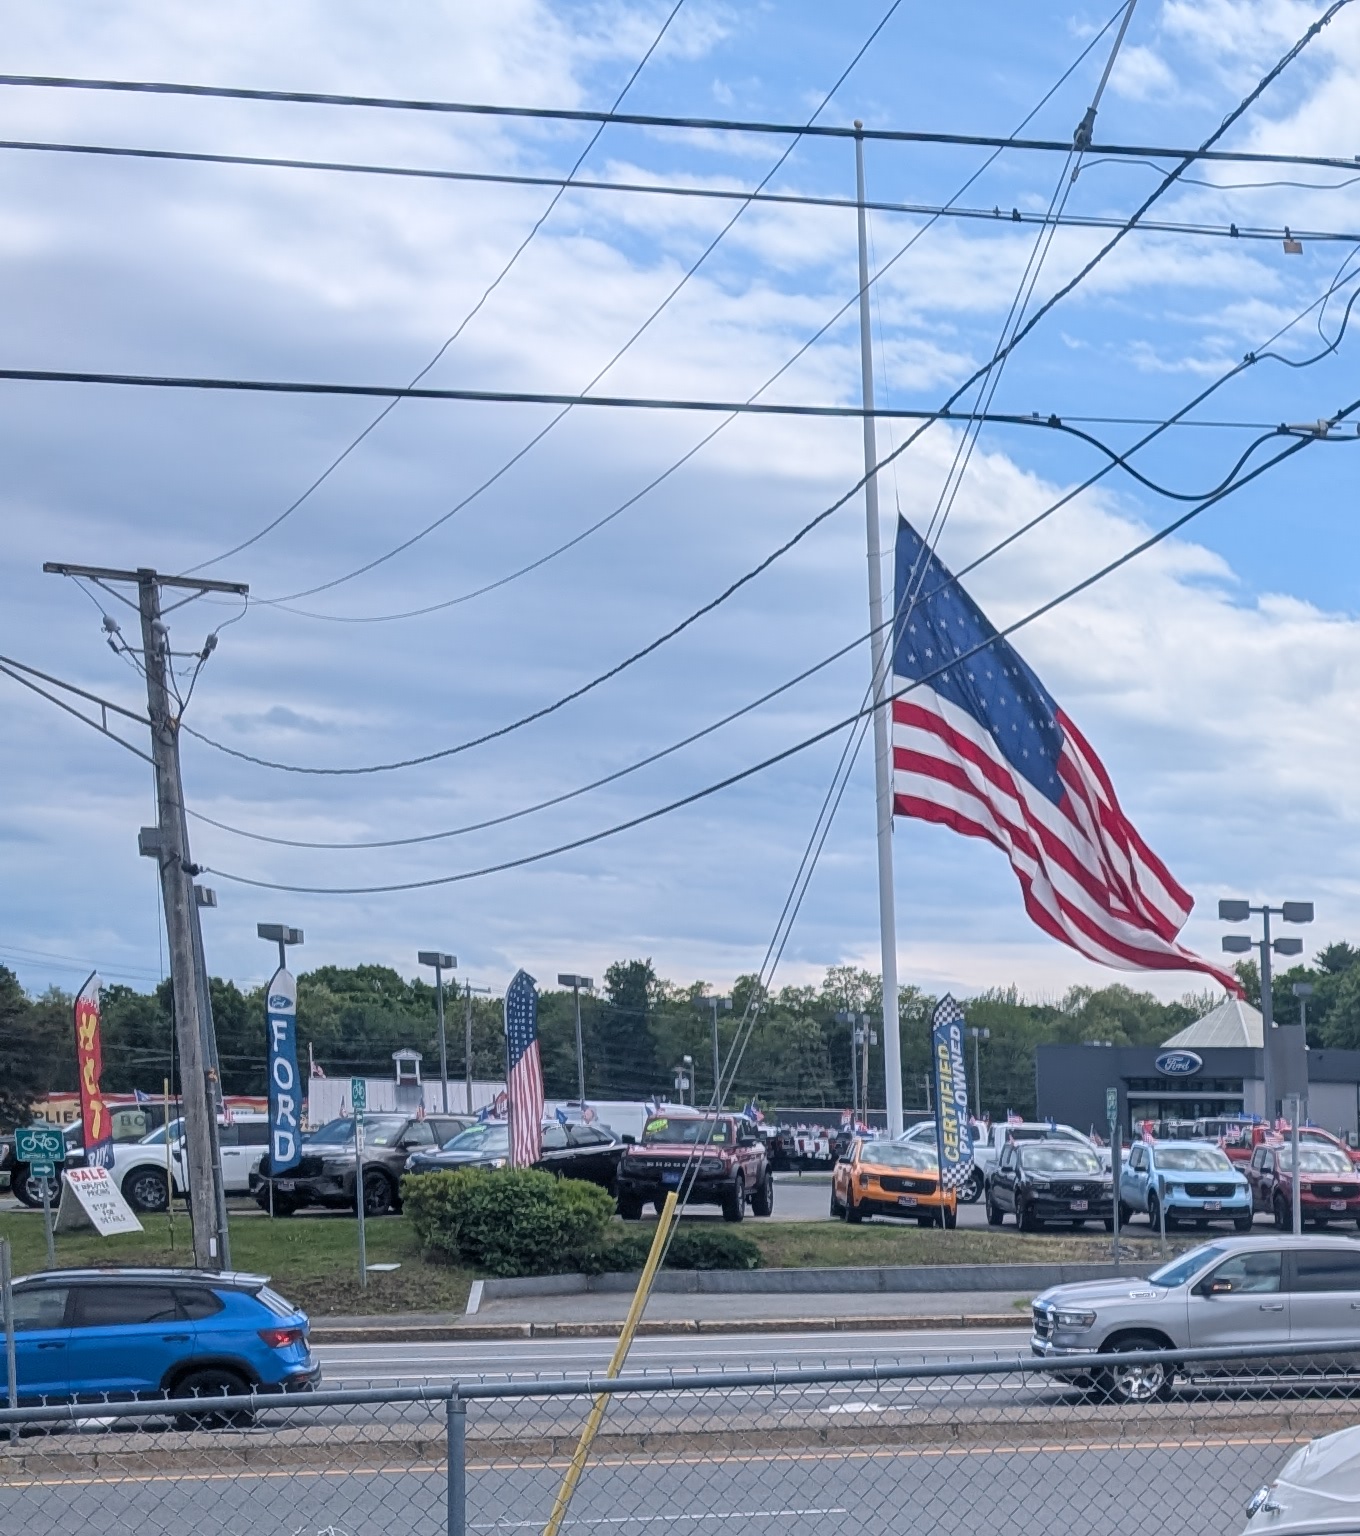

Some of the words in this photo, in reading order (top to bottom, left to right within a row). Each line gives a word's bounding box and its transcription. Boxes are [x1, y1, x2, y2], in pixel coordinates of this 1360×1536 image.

[270, 1019, 297, 1163] FORD
[937, 1043, 961, 1163] CERTIFIED
[950, 1024, 971, 1156] PRE-OWNED
[1163, 1056, 1191, 1071] Ford
[70, 1168, 108, 1182] SALE
